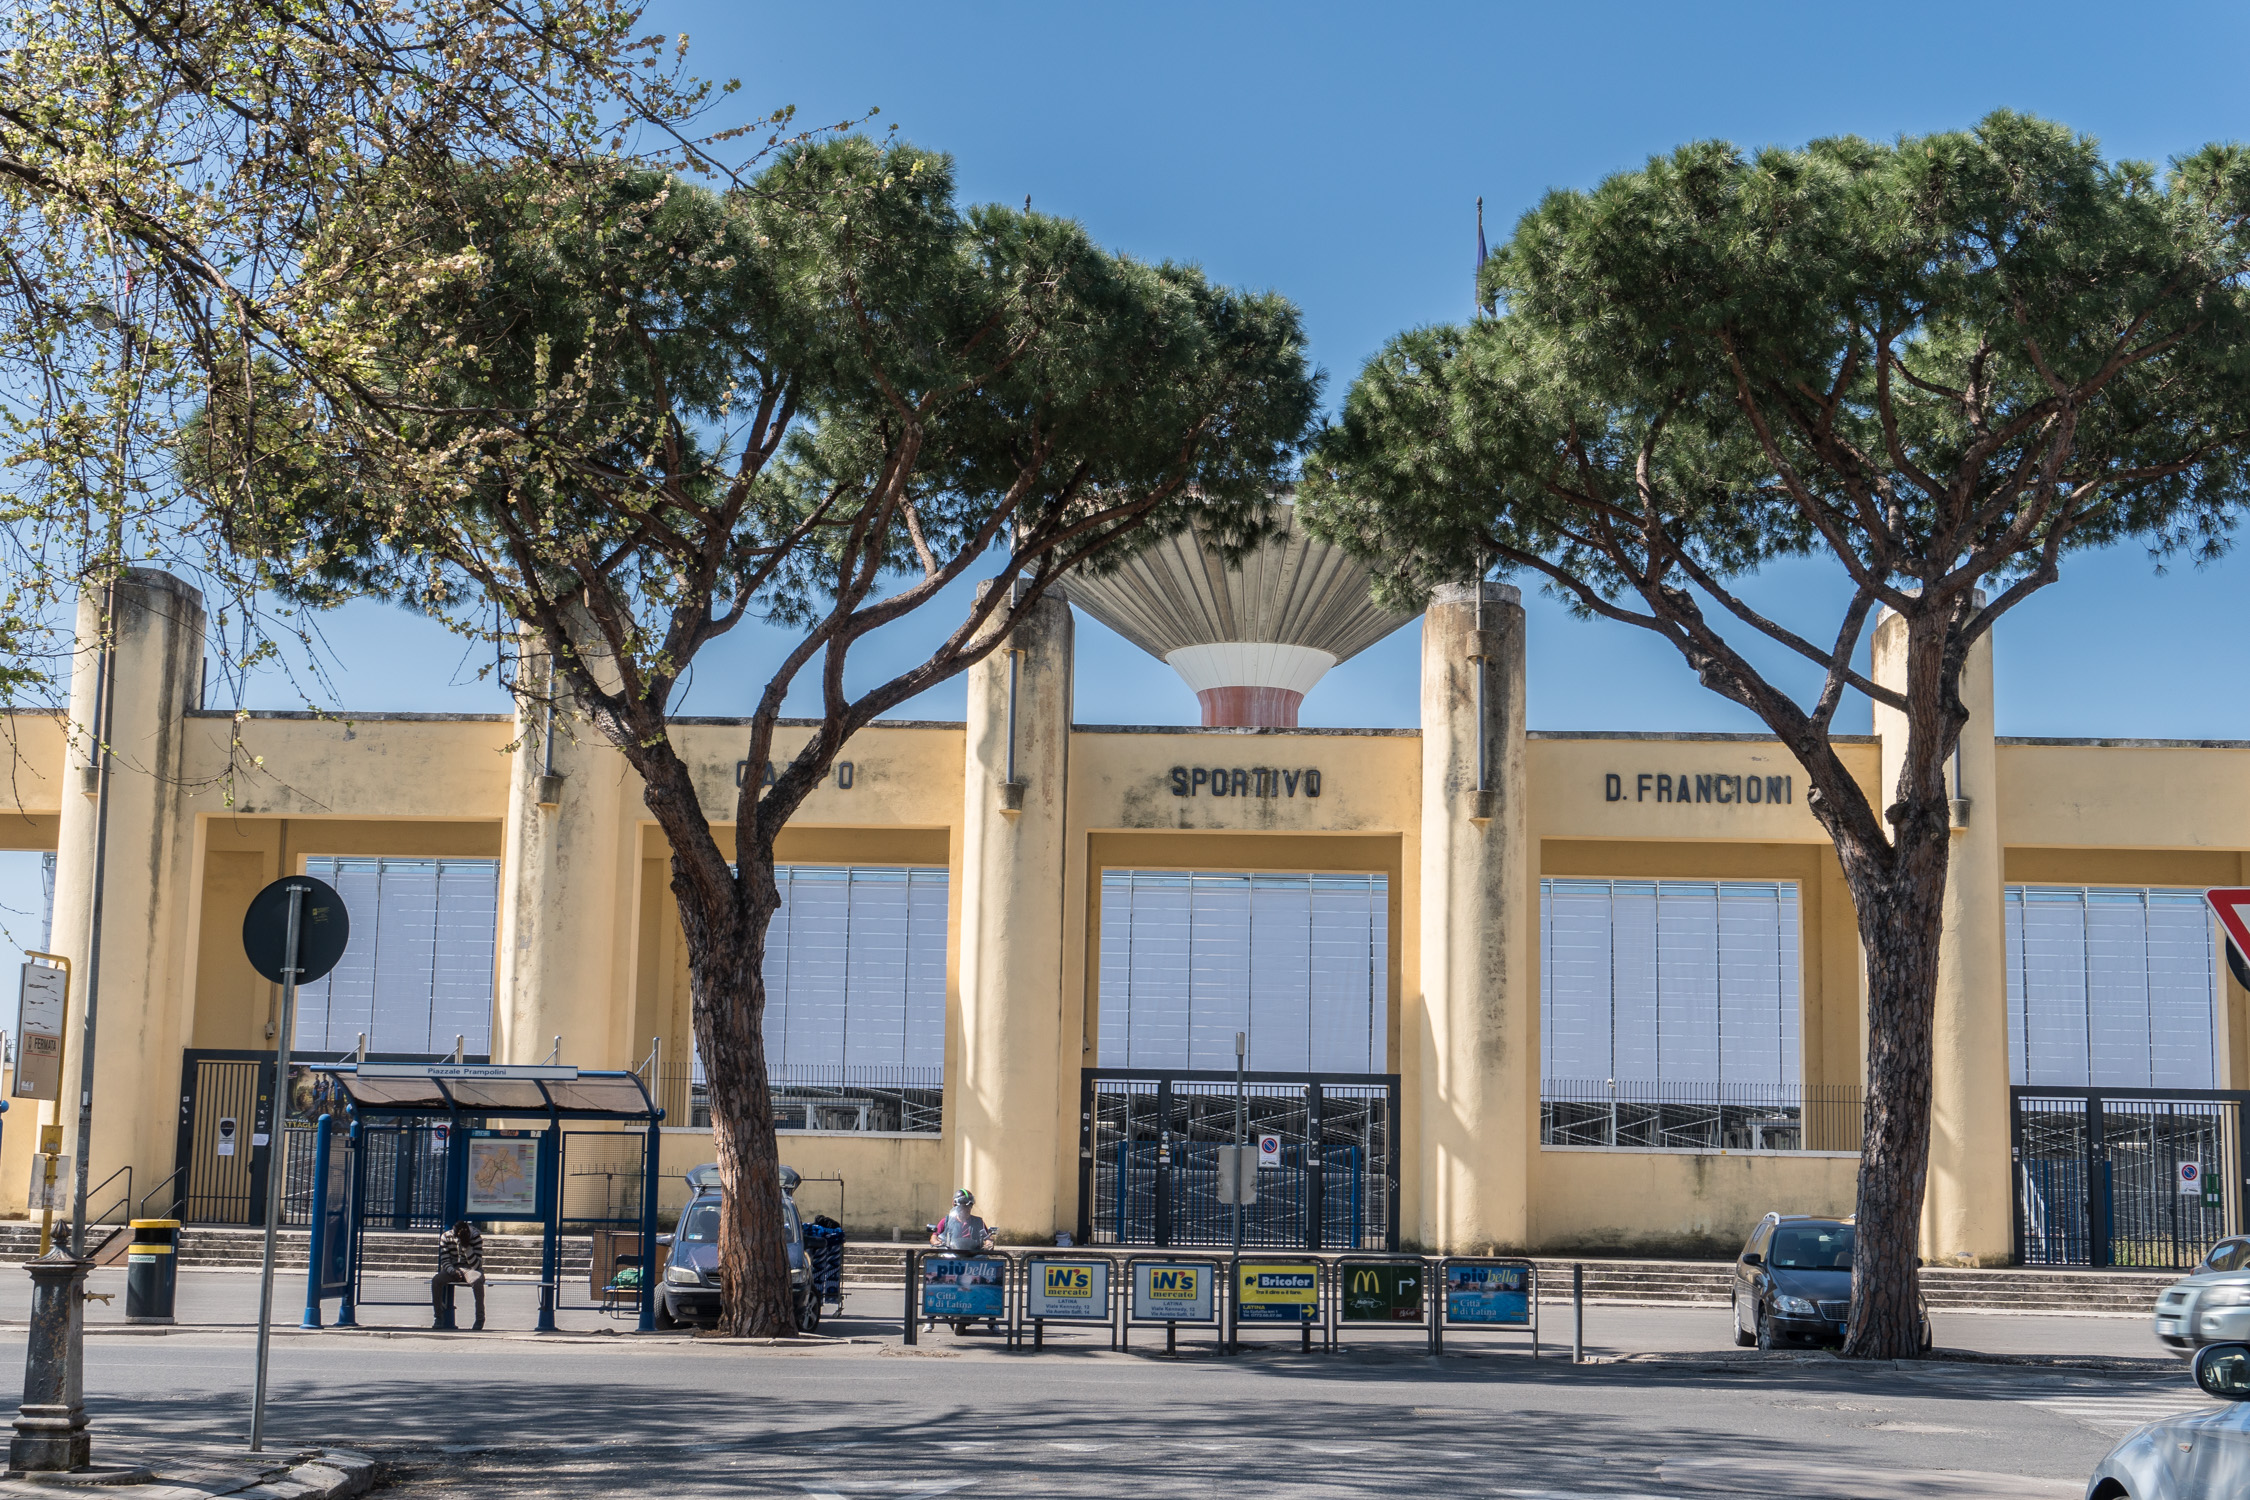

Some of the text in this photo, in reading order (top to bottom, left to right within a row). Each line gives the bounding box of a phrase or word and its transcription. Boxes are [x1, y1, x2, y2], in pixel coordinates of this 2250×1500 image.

[736, 760, 854, 789] CAO
[1172, 767, 1321, 797] SPORTIVO
[1605, 773, 1792, 804] D. FRANCIONI
[34, 1037, 56, 1052] FERMATA
[427, 1067, 507, 1076] Piazzale Prampolini
[1261, 1276, 1310, 1287] Bricofer
[936, 1292, 956, 1300] Città
[935, 1300, 972, 1309] di Latina
[1471, 1308, 1496, 1316] Latina
